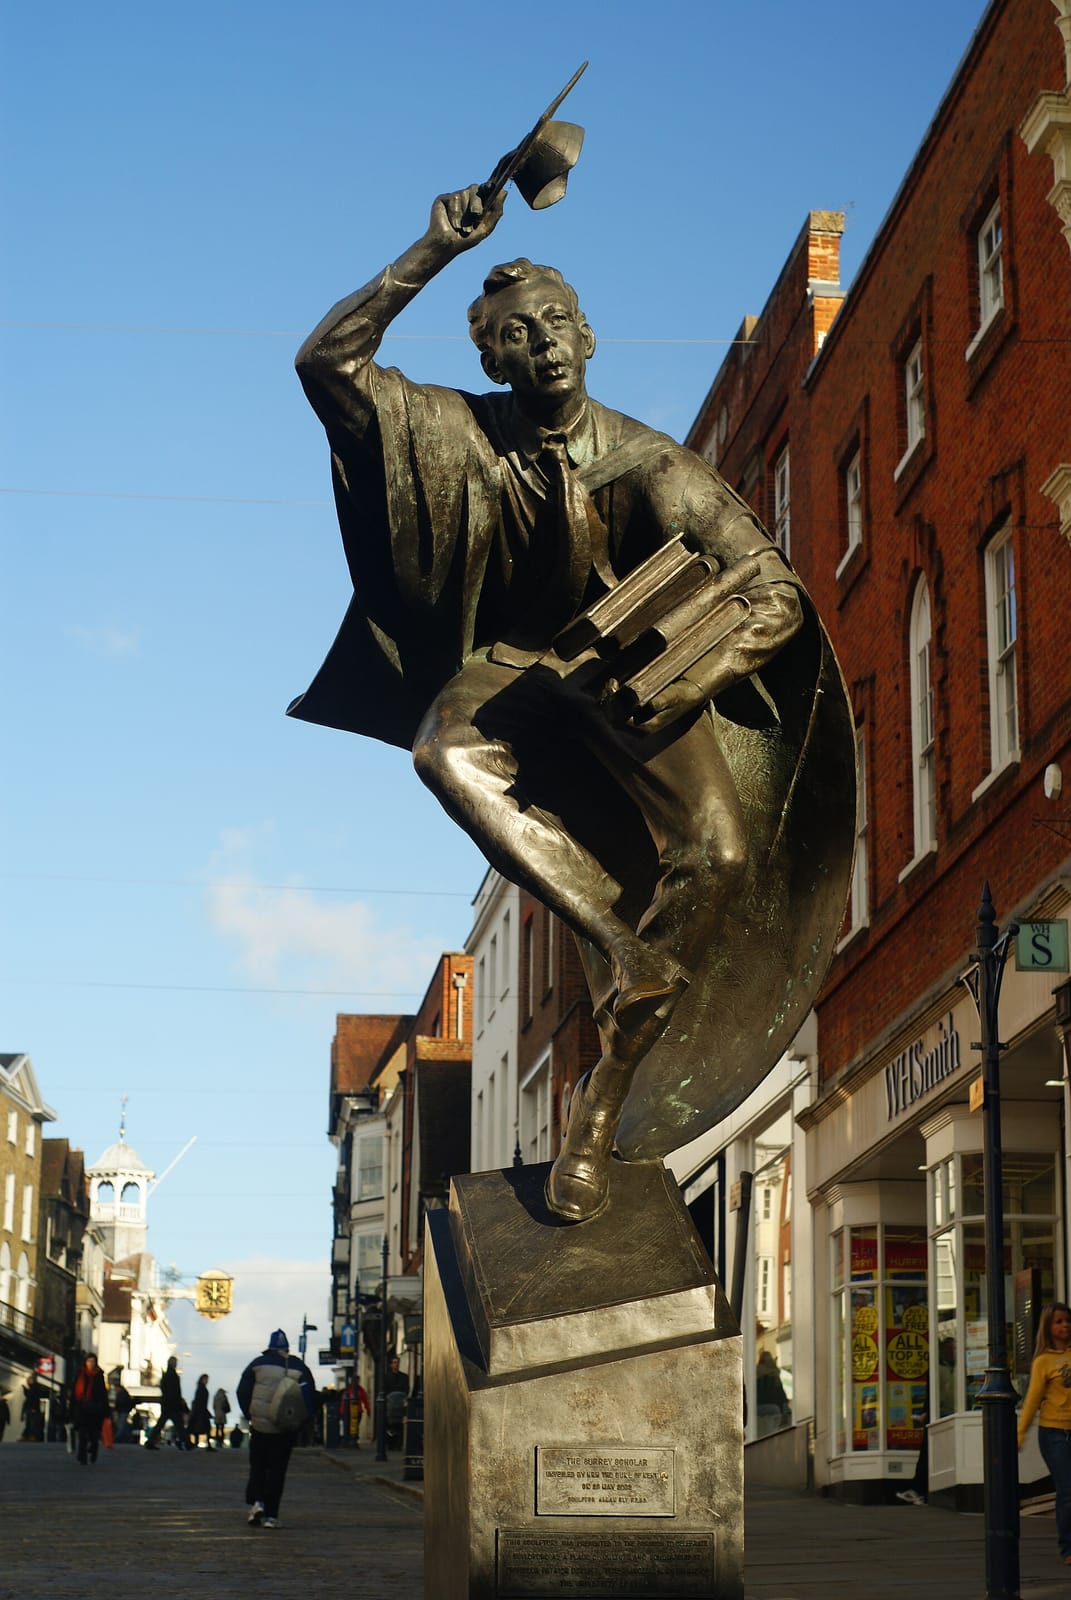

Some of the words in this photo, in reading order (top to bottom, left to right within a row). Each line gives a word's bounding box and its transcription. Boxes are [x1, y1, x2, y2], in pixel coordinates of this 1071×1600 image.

[1030, 923, 1050, 934] WH
[1031, 934, 1052, 966] S
[884, 1011, 960, 1122] WHSmith
[896, 1335, 923, 1348] ALL
[888, 1351, 913, 1361] TOP
[917, 1351, 929, 1361] 50
[567, 1457, 581, 1466] THE
[583, 1457, 613, 1466] SURREY
[614, 1458, 648, 1467] SCHOLAR
